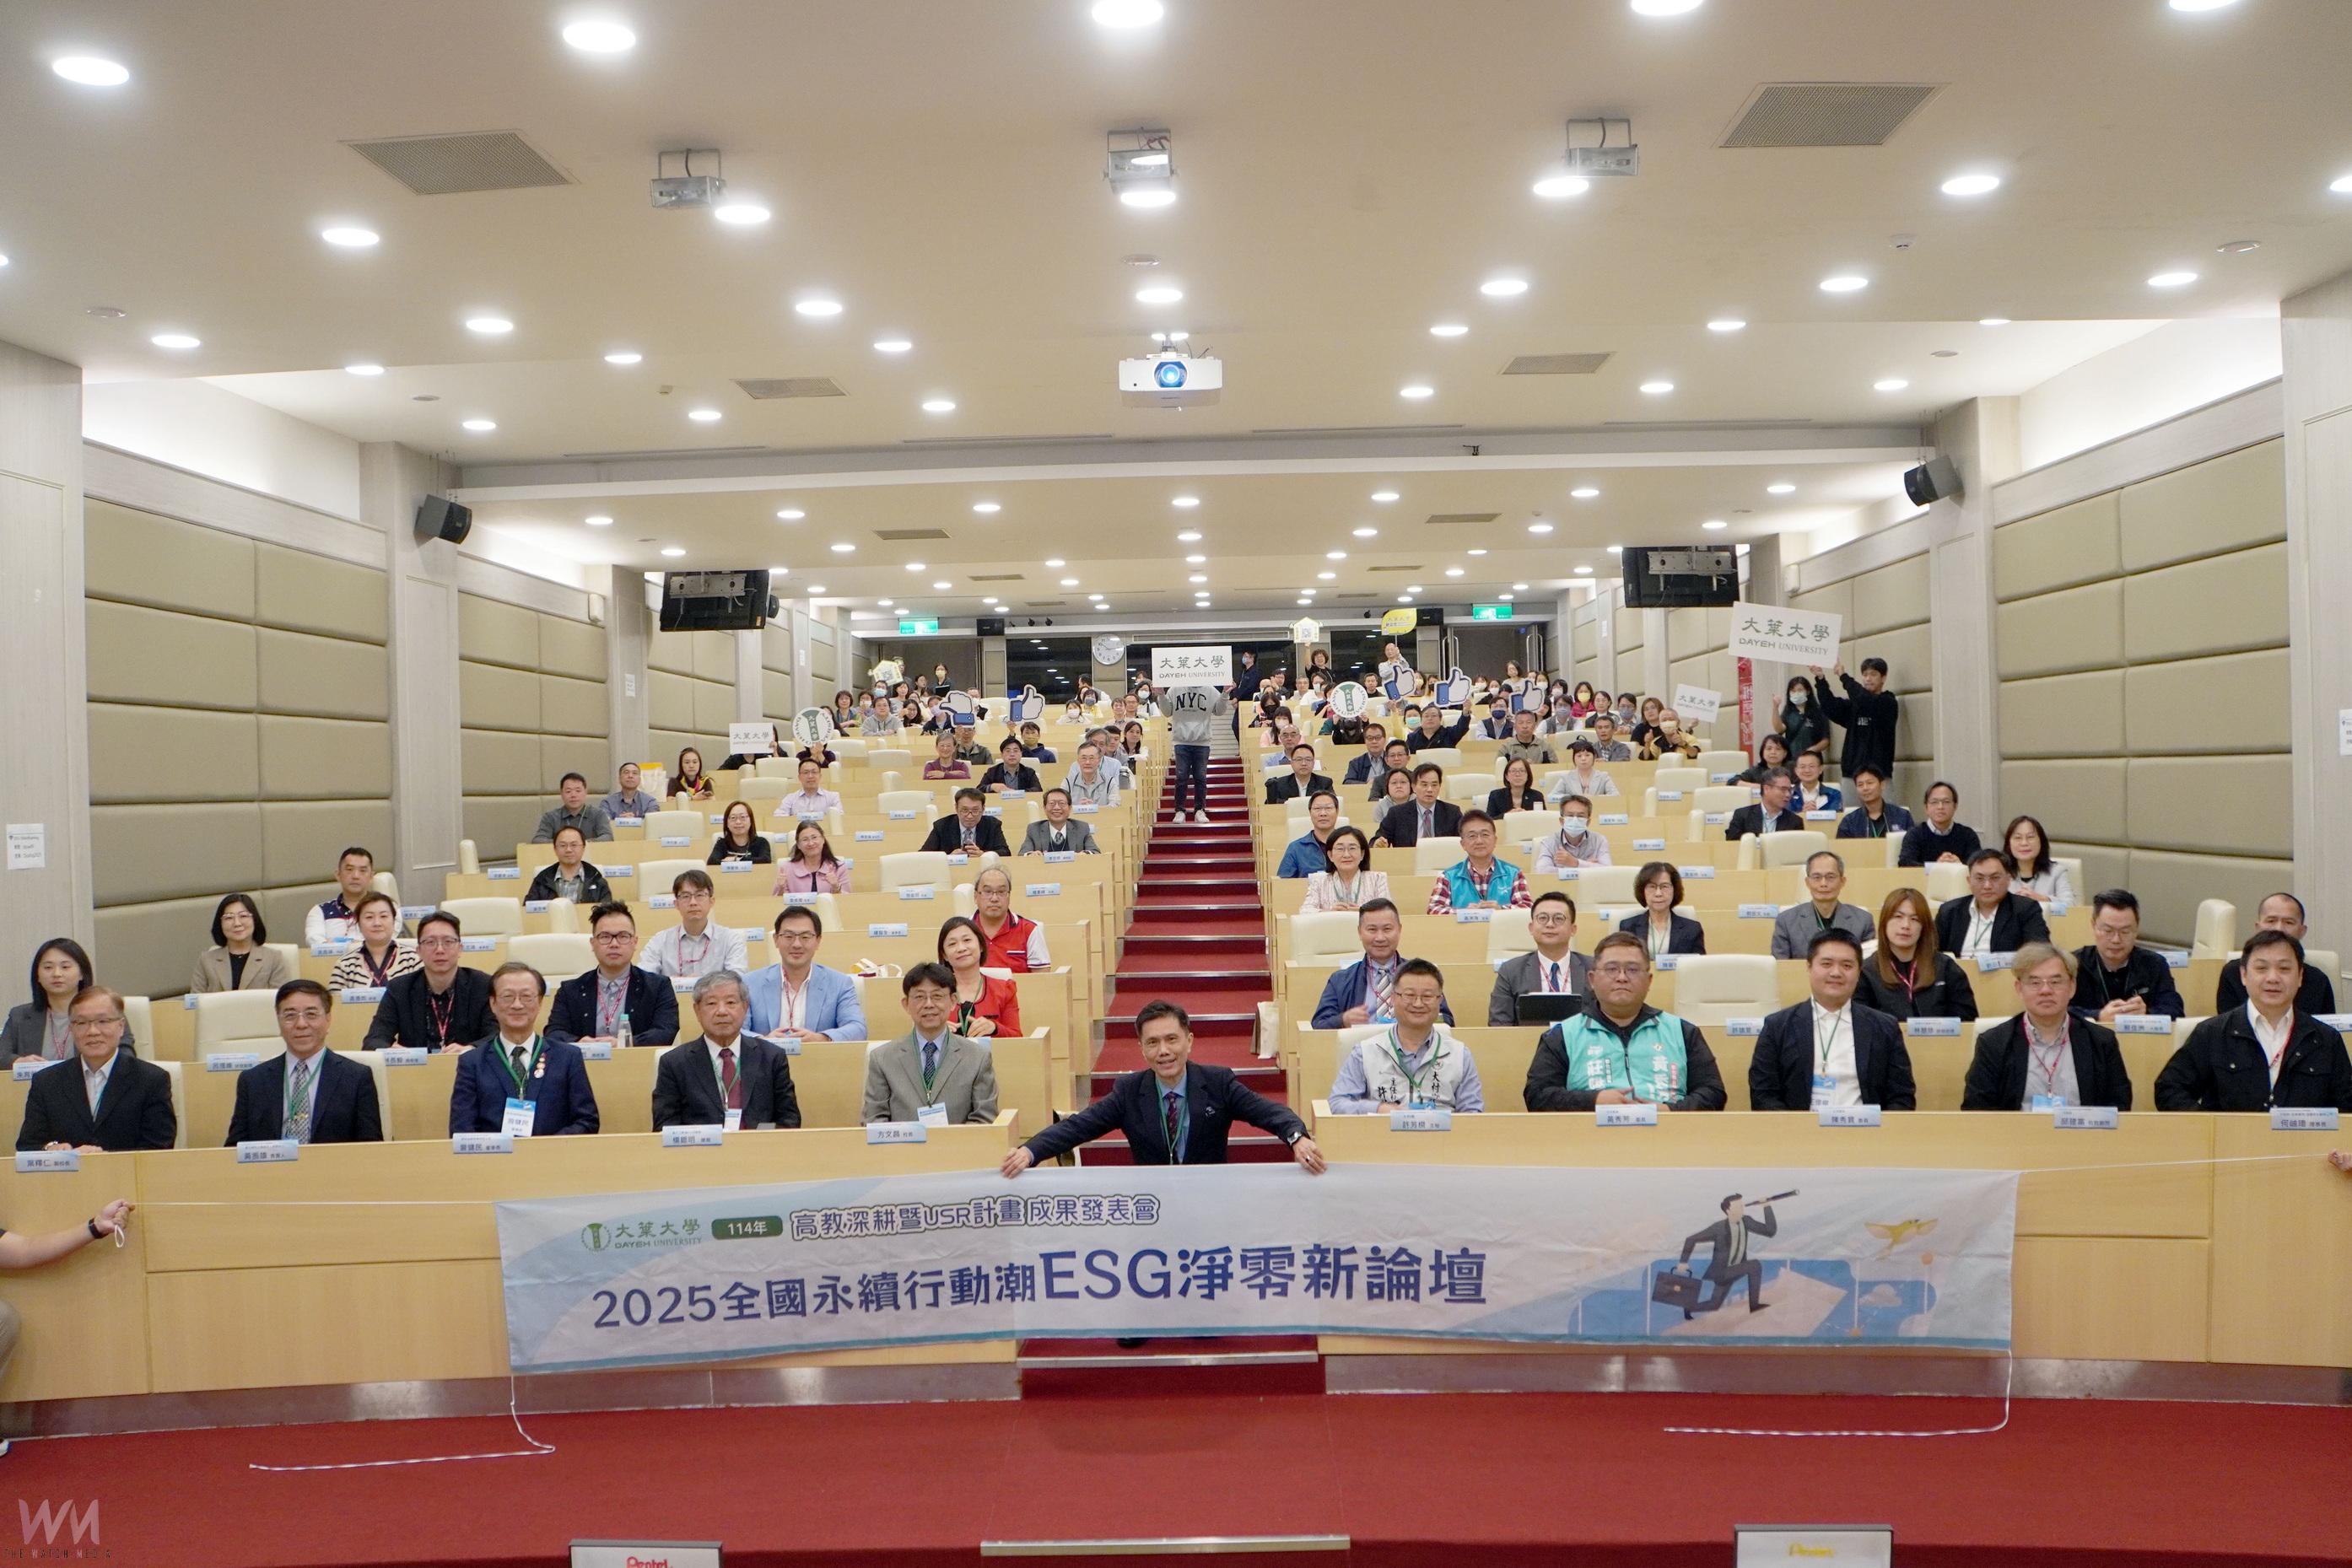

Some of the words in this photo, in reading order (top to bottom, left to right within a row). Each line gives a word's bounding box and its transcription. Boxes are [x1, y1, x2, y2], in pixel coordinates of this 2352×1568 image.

[1741, 617, 1830, 642] 大葉大學
[1739, 638, 1776, 649] DAYEH
[1778, 643, 1829, 655] UNIVERSITY
[1160, 655, 1224, 669] 大葉大學
[1175, 692, 1207, 712] NYC
[1679, 694, 1716, 707] 大葉大學
[733, 731, 769, 740] 大葉大學
[793, 1196, 1158, 1237] 高教深耕暨USR計畫成果發表會
[615, 1219, 701, 1238] 大葉大學
[726, 1220, 768, 1237] 114年
[654, 1237, 702, 1247] UNIVERSITY
